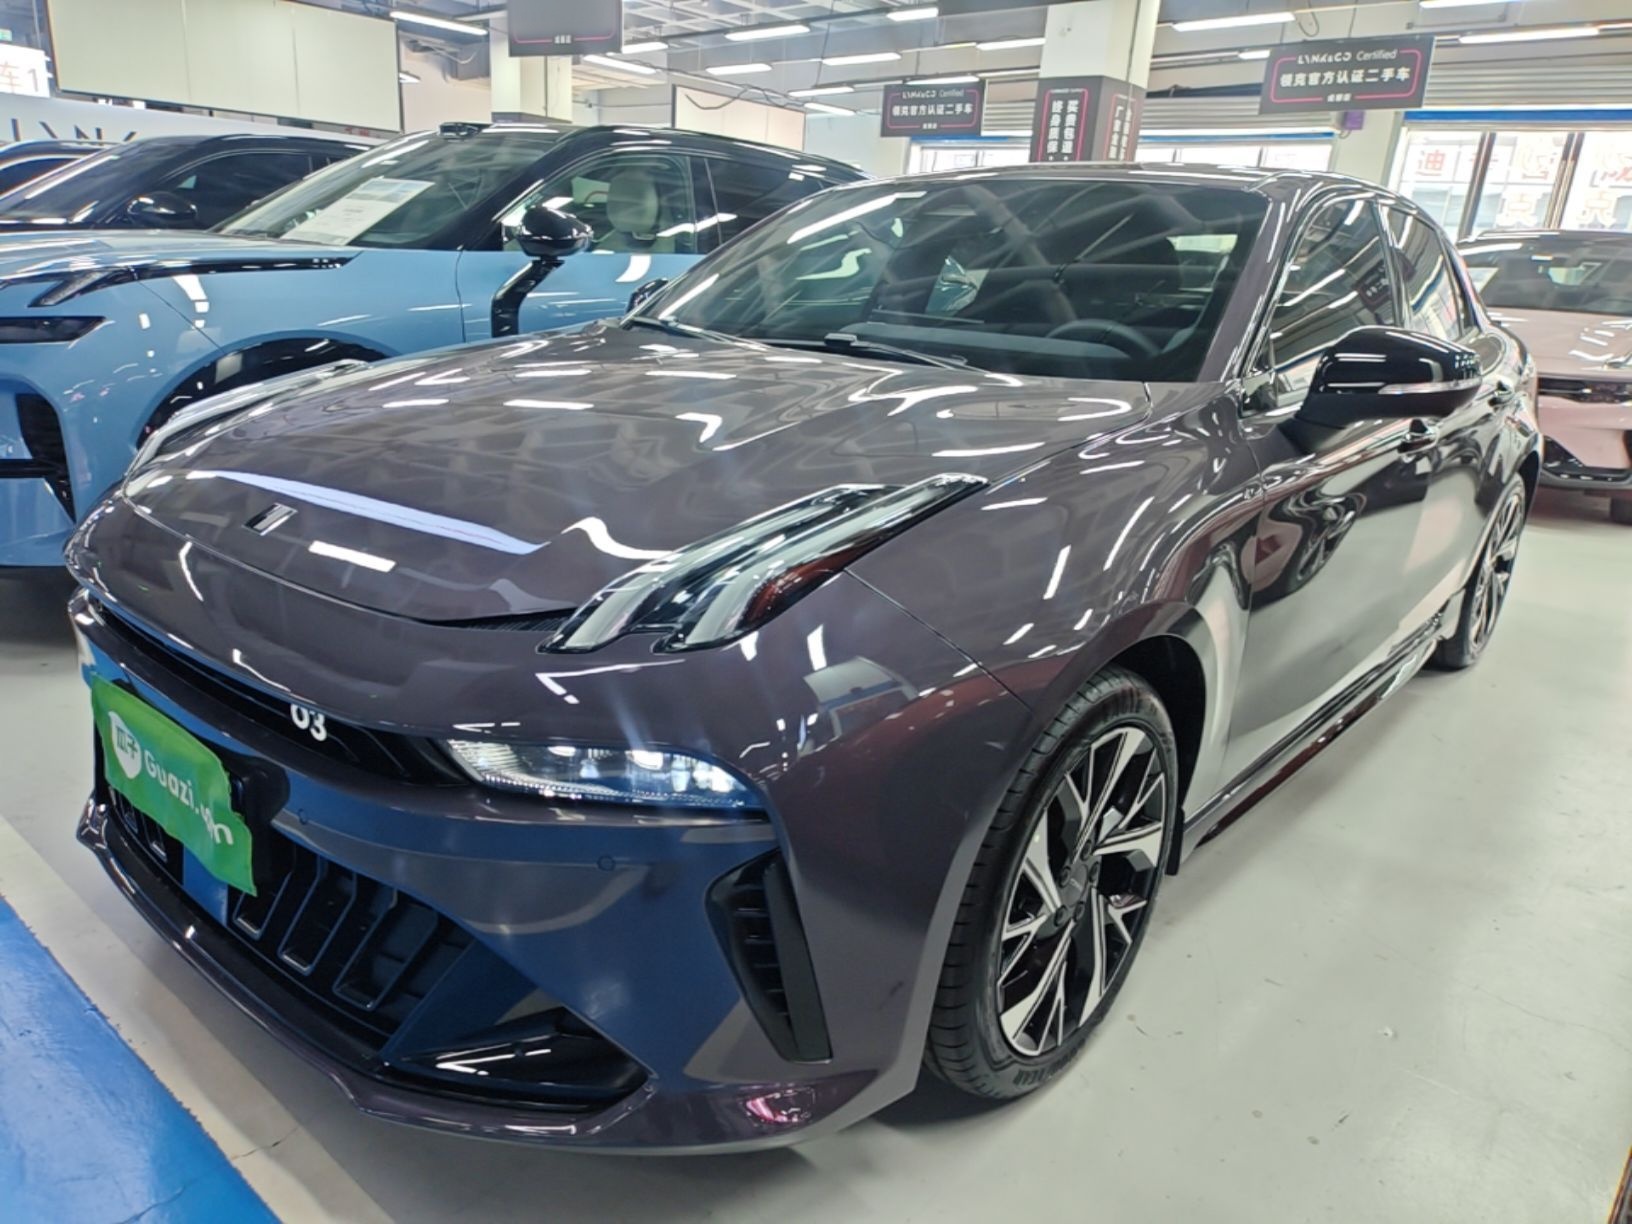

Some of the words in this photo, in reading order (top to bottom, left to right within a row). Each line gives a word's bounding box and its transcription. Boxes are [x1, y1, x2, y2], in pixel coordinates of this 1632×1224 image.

[1356, 49, 1399, 62] Certified
[1280, 66, 1411, 88] 领克官方认证二手车
[290, 703, 328, 742] 03
